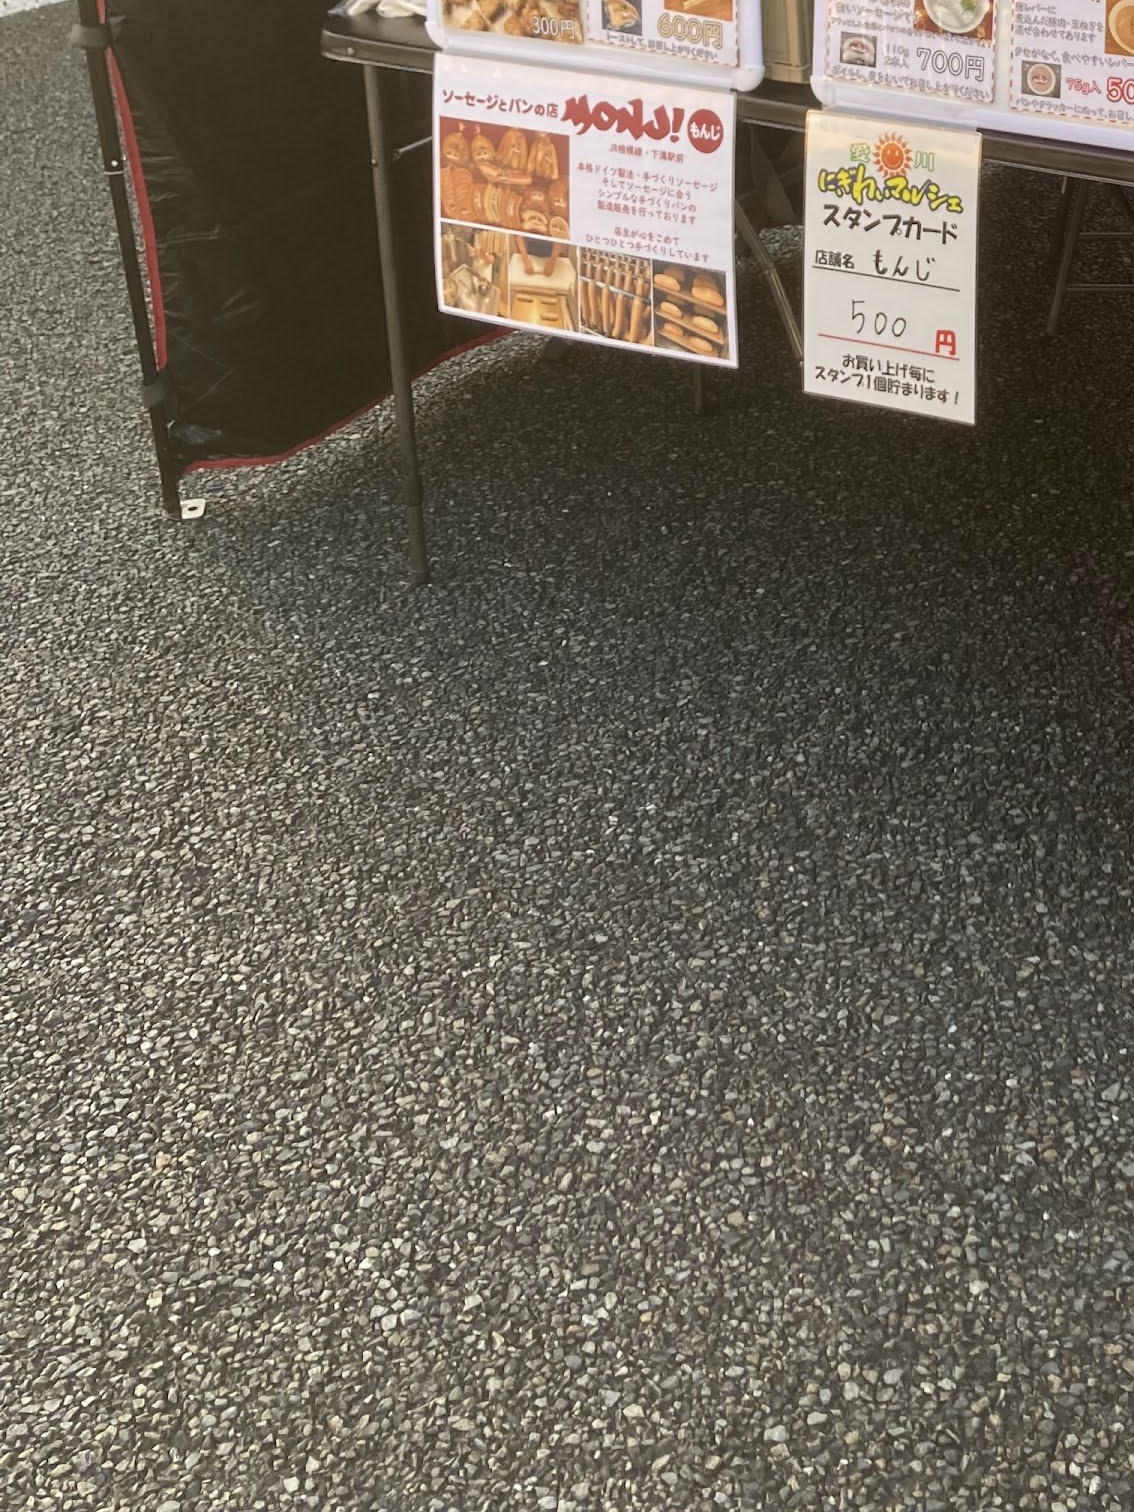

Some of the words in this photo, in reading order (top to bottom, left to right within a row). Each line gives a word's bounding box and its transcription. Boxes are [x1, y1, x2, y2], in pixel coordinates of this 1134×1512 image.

[531, 15, 576, 40] 300円
[657, 12, 723, 50] 600円
[916, 46, 985, 83] 700円
[1065, 76, 1102, 95] 75g入
[442, 88, 560, 119] ソーセージとパンの店
[689, 121, 721, 141] もんじ
[597, 188, 697, 213] シンプルな手づくりパンの
[601, 176, 692, 201] そしてソーセージに合う
[817, 162, 965, 214] にぎわいマルシェ
[596, 199, 697, 226] 製造販売を行っております
[822, 203, 959, 245] スタンプカード
[585, 233, 710, 264] ひとつひとつ手づくりしています
[613, 226, 680, 246] 店主が心をこめて
[815, 249, 855, 270] 店舗名
[872, 248, 936, 282] もんじ
[851, 298, 908, 338] 500
[934, 328, 958, 356] 円
[842, 353, 936, 384] お買い上げ毎に
